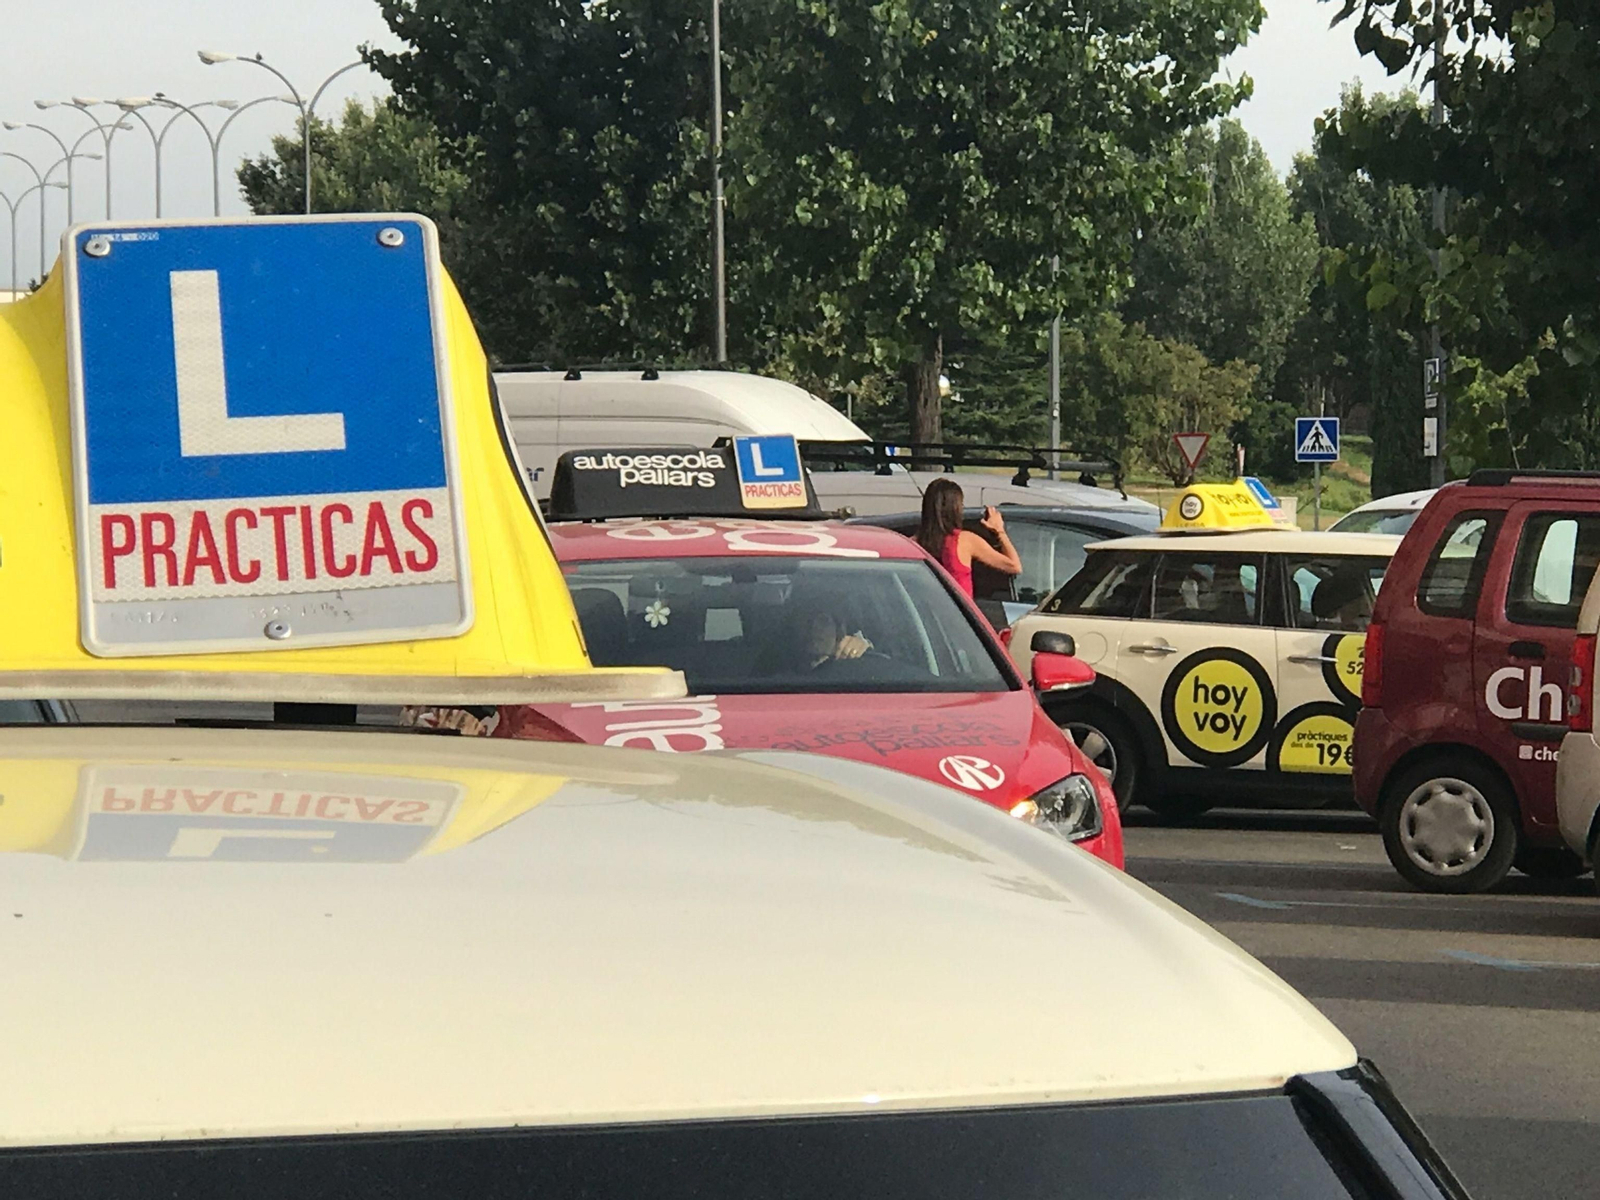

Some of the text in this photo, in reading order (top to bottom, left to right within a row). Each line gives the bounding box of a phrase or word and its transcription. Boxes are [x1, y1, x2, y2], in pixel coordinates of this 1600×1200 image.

[169, 269, 347, 458] L
[573, 451, 726, 470] autoescola
[750, 442, 784, 477] L
[619, 467, 716, 489] pallars
[744, 483, 802, 498] PRACTICAS
[100, 498, 439, 589] PRACTICAS
[1050, 598, 1062, 611] 3
[1193, 675, 1248, 713] hoy
[1193, 711, 1248, 742] voy
